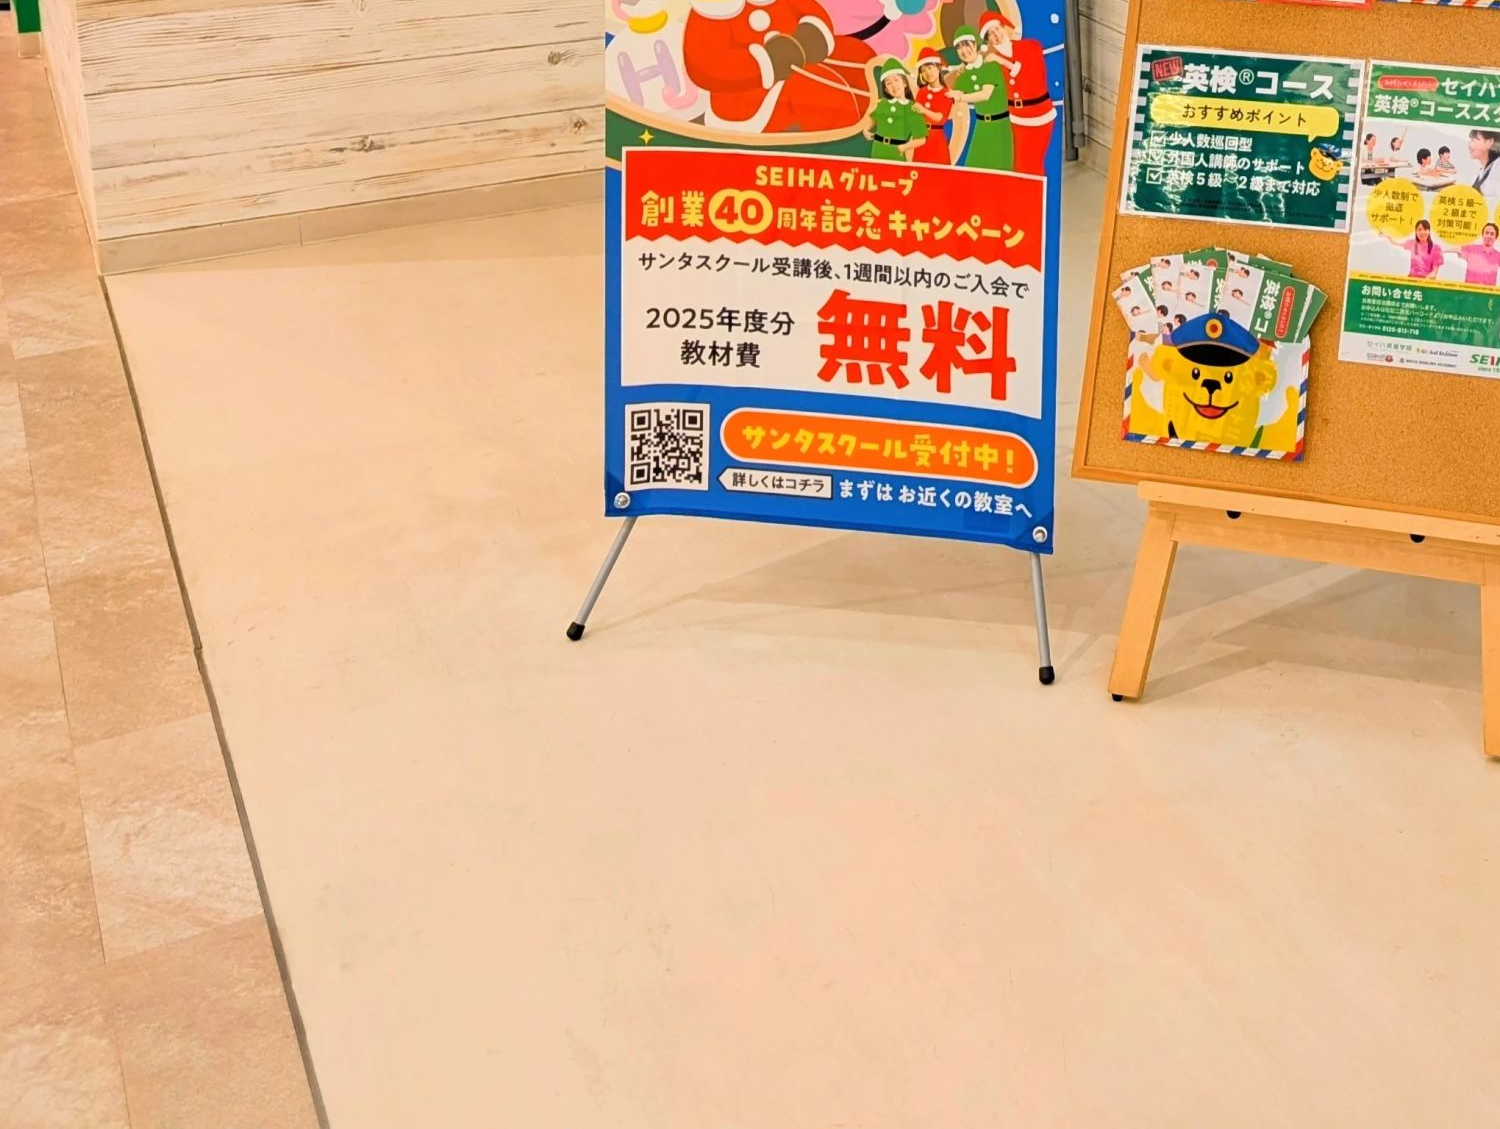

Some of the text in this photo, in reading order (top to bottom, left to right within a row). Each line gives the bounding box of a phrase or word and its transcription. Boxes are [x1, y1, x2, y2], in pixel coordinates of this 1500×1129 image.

[1153, 60, 1181, 77] NEW
[1182, 103, 1306, 128] おすすめポイント
[1168, 132, 1253, 152] 少人数巡回型
[1167, 151, 1305, 176] 外国人講師のサポート
[1373, 189, 1418, 202] 少人数制で
[640, 188, 1025, 247] 創業40周年記念キャンペーン
[1443, 209, 1477, 218] 2級まで
[638, 251, 1030, 299] サンタスクール受講後、1週間以内のご入会で
[1361, 285, 1423, 301] お問い合せ先
[645, 305, 796, 337] 2025年度分
[680, 339, 761, 368] 教材費
[816, 289, 1016, 401] 無料
[732, 472, 825, 493] 詳しくはコチラ
